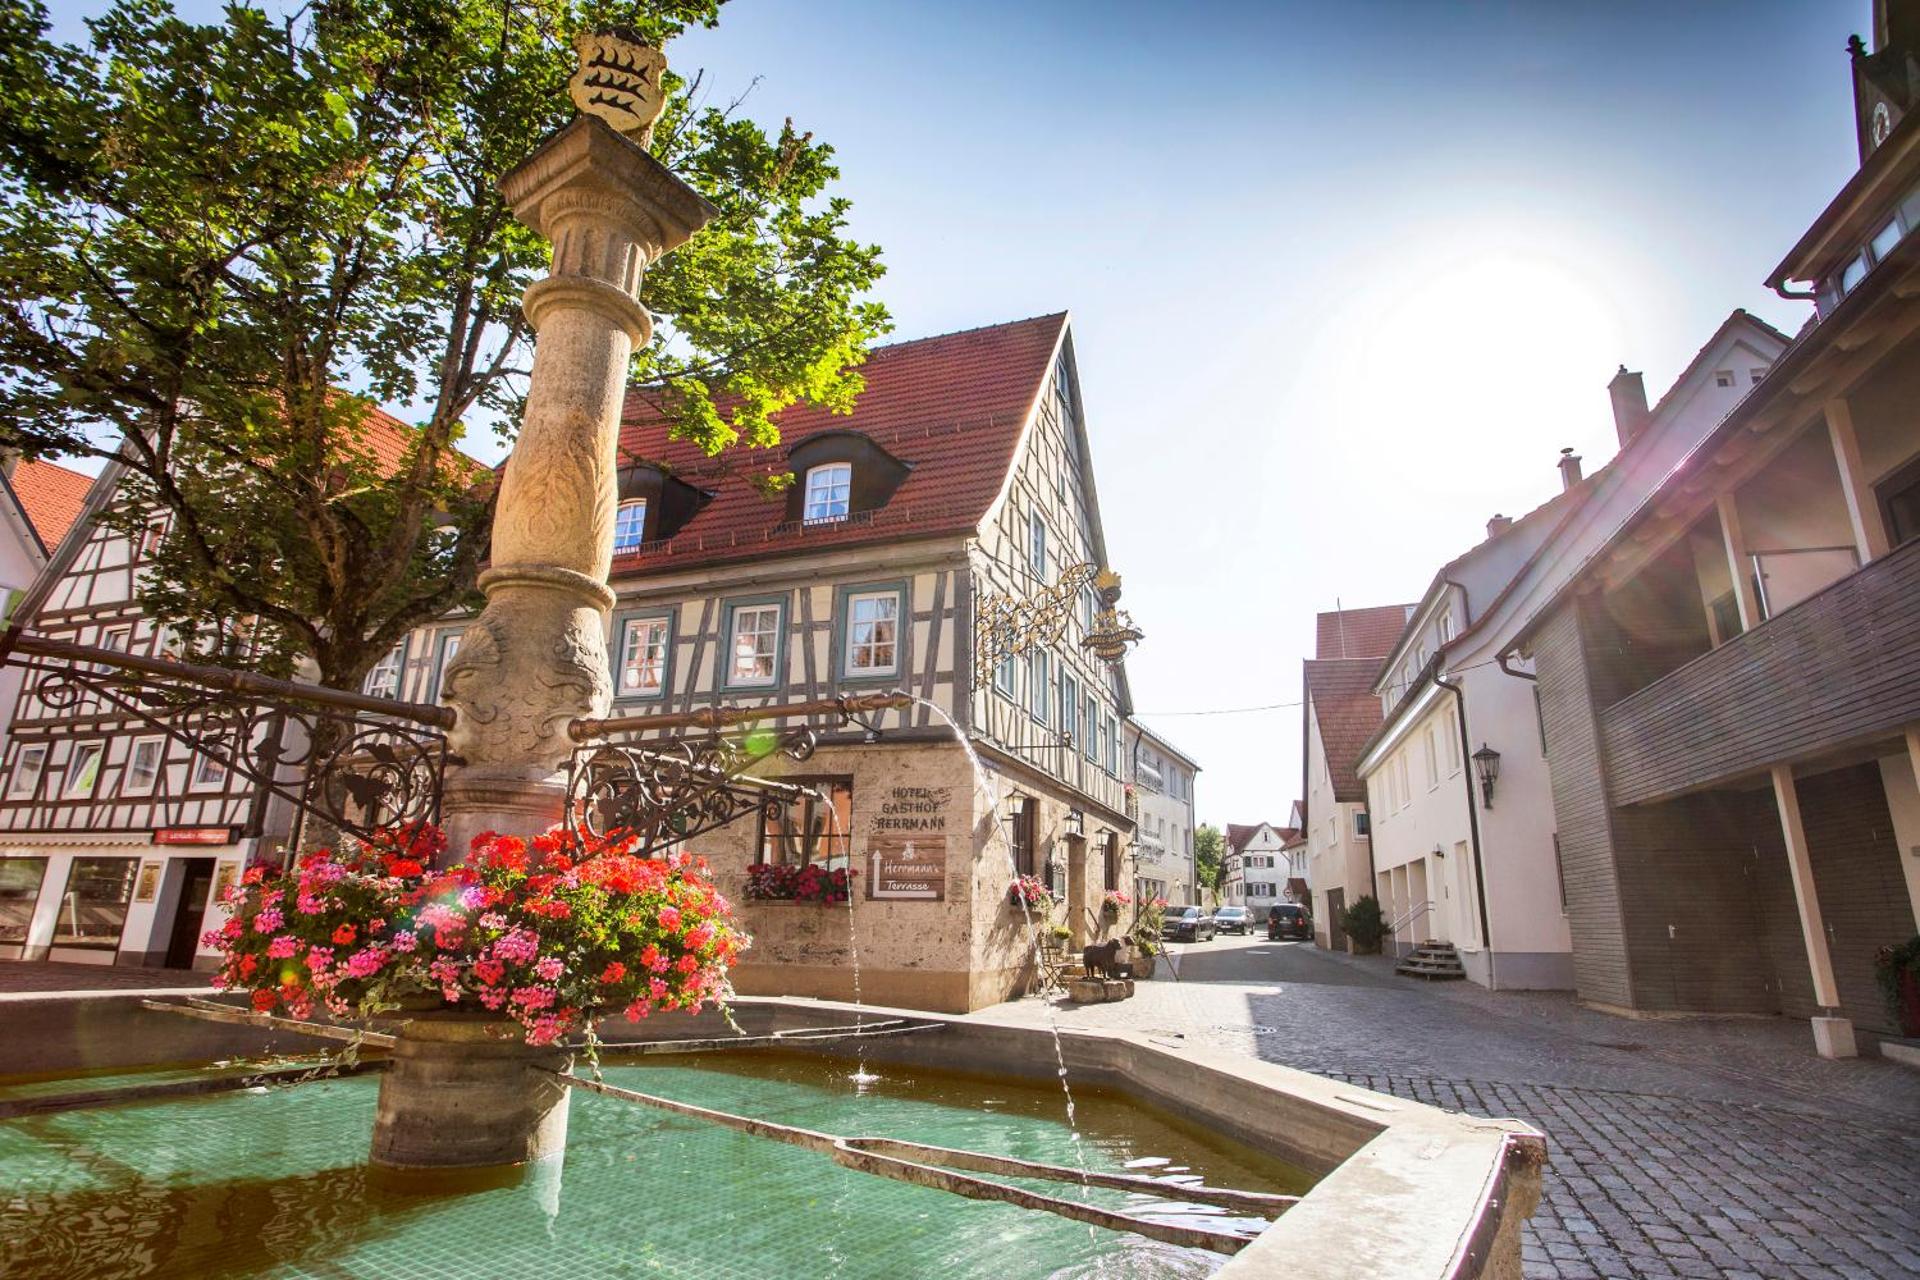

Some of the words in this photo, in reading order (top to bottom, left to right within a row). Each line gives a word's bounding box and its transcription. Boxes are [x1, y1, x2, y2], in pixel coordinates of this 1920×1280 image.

[892, 787, 930, 799] HOTEL
[882, 802, 938, 814] GASTHOF
[877, 816, 945, 831] HERRMANN
[887, 880, 930, 891] Terrasse
